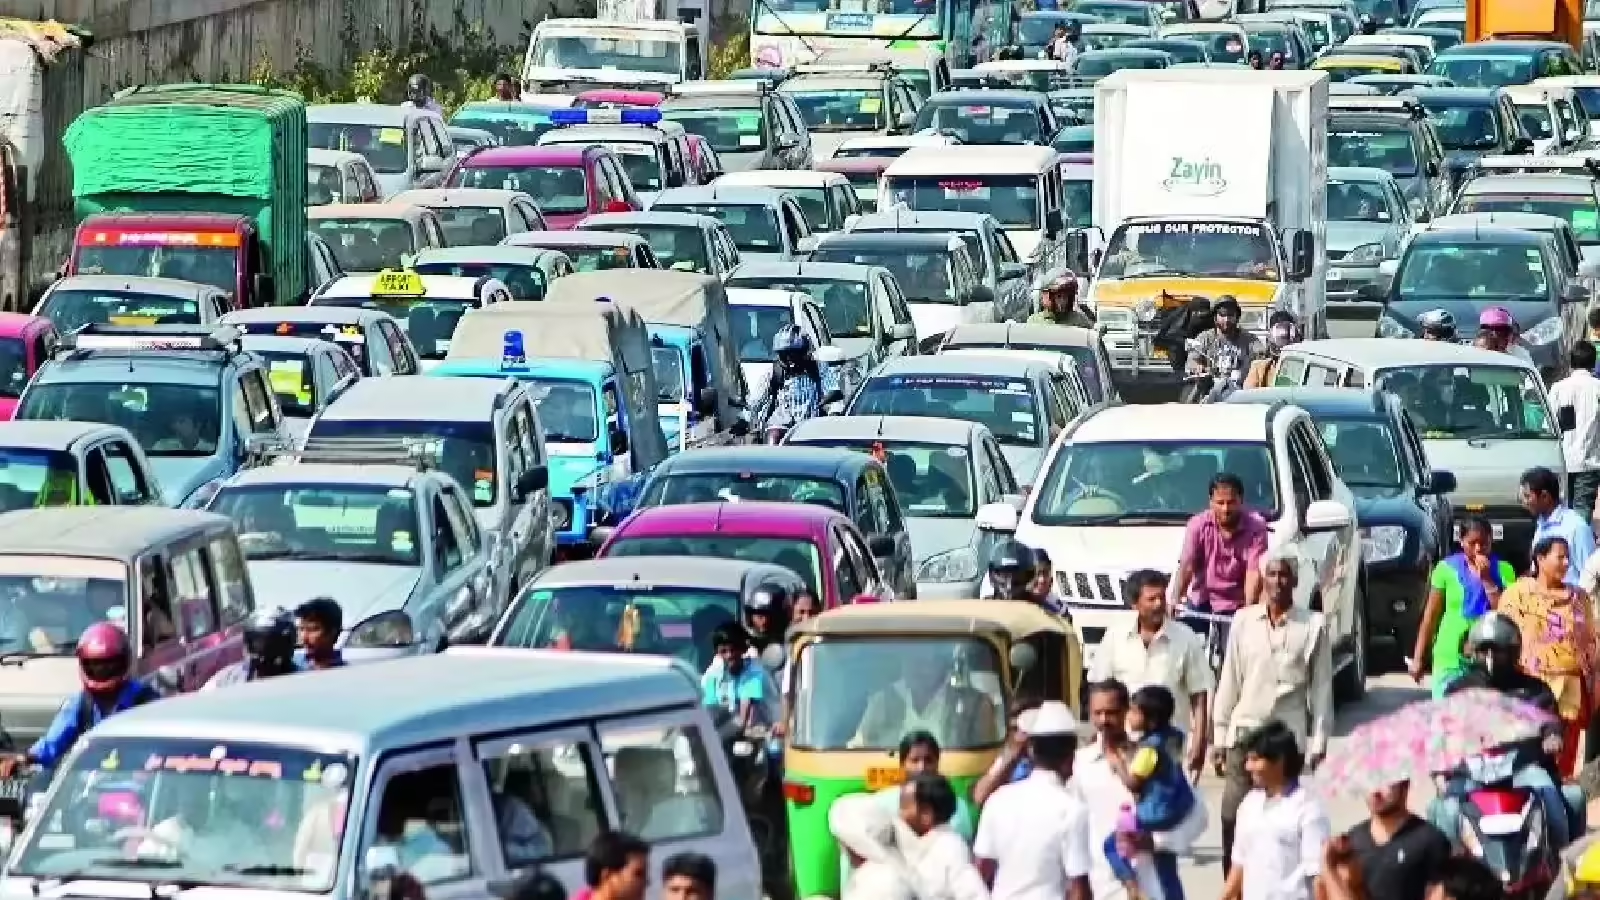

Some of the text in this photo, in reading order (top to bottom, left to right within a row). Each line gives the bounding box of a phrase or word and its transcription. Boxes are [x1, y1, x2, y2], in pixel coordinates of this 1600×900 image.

[1171, 156, 1222, 184] Zayin
[1165, 223, 1189, 234] OUR
[1192, 223, 1260, 237] PROTECTOR
